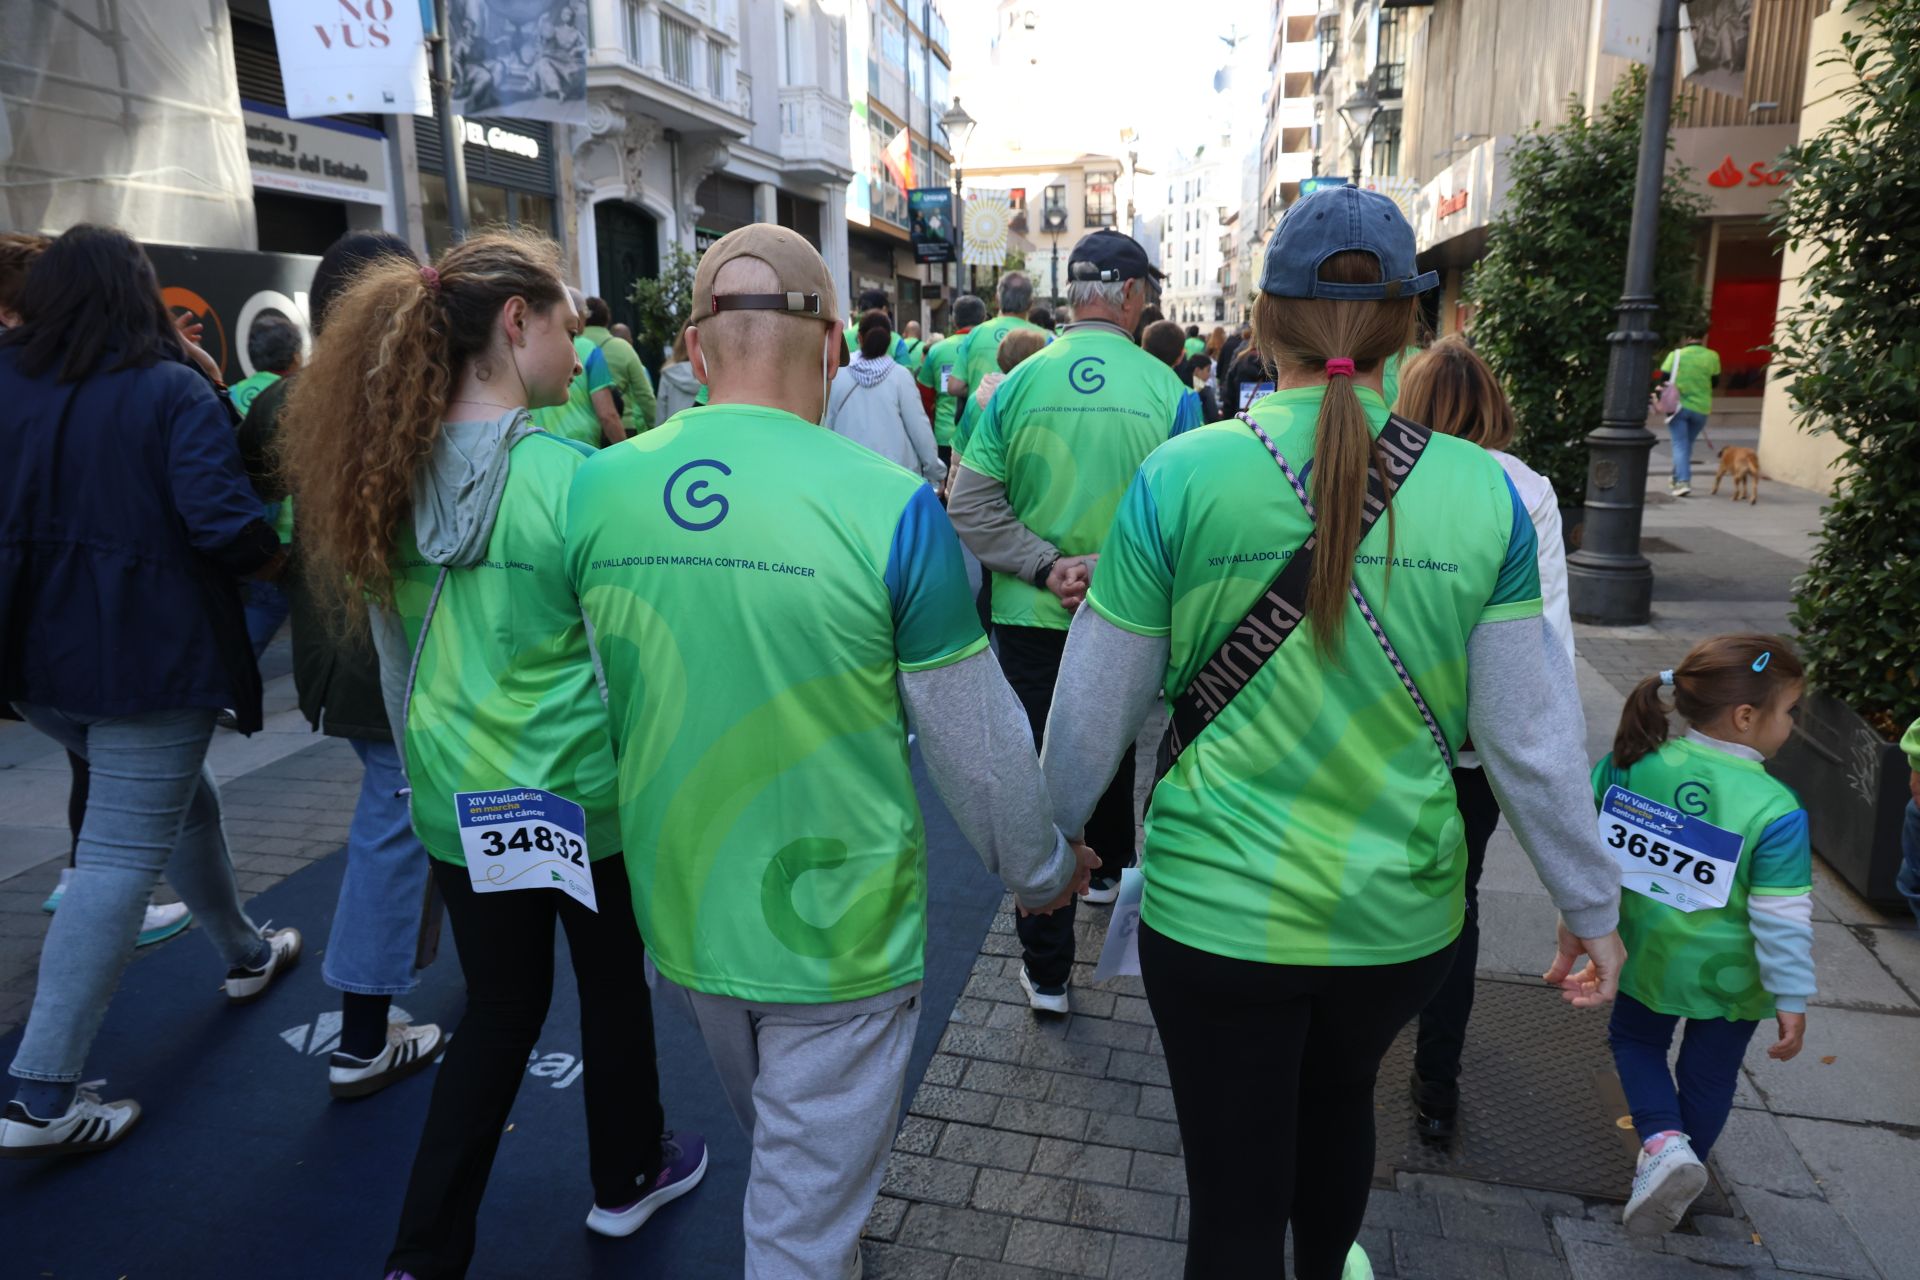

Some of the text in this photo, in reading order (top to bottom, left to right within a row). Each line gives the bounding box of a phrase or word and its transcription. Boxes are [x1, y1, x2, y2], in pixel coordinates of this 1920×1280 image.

[338, 0, 393, 21] NO
[314, 23, 390, 49] VUS
[287, 133, 297, 152] y
[466, 121, 488, 146] EL
[298, 153, 320, 173] del
[322, 158, 368, 182] Estado
[591, 556, 815, 577] XIV VALLADOLID EN MARCHA CONTRA EL CÁNCER
[1208, 556, 1224, 567] XIV
[1226, 550, 1293, 564] VALLADOLID
[1402, 558, 1415, 567] EL
[1417, 558, 1459, 573] CÁNCER
[468, 793, 541, 807] XIV Valladolid
[470, 802, 520, 814] en marcha
[1615, 791, 1678, 823] XIV Valladolid
[471, 808, 545, 822] contra el cáncer
[1611, 806, 1636, 822] contra
[1635, 816, 1646, 826] el
[481, 827, 585, 868] 34832
[1608, 824, 1716, 884] 36576
